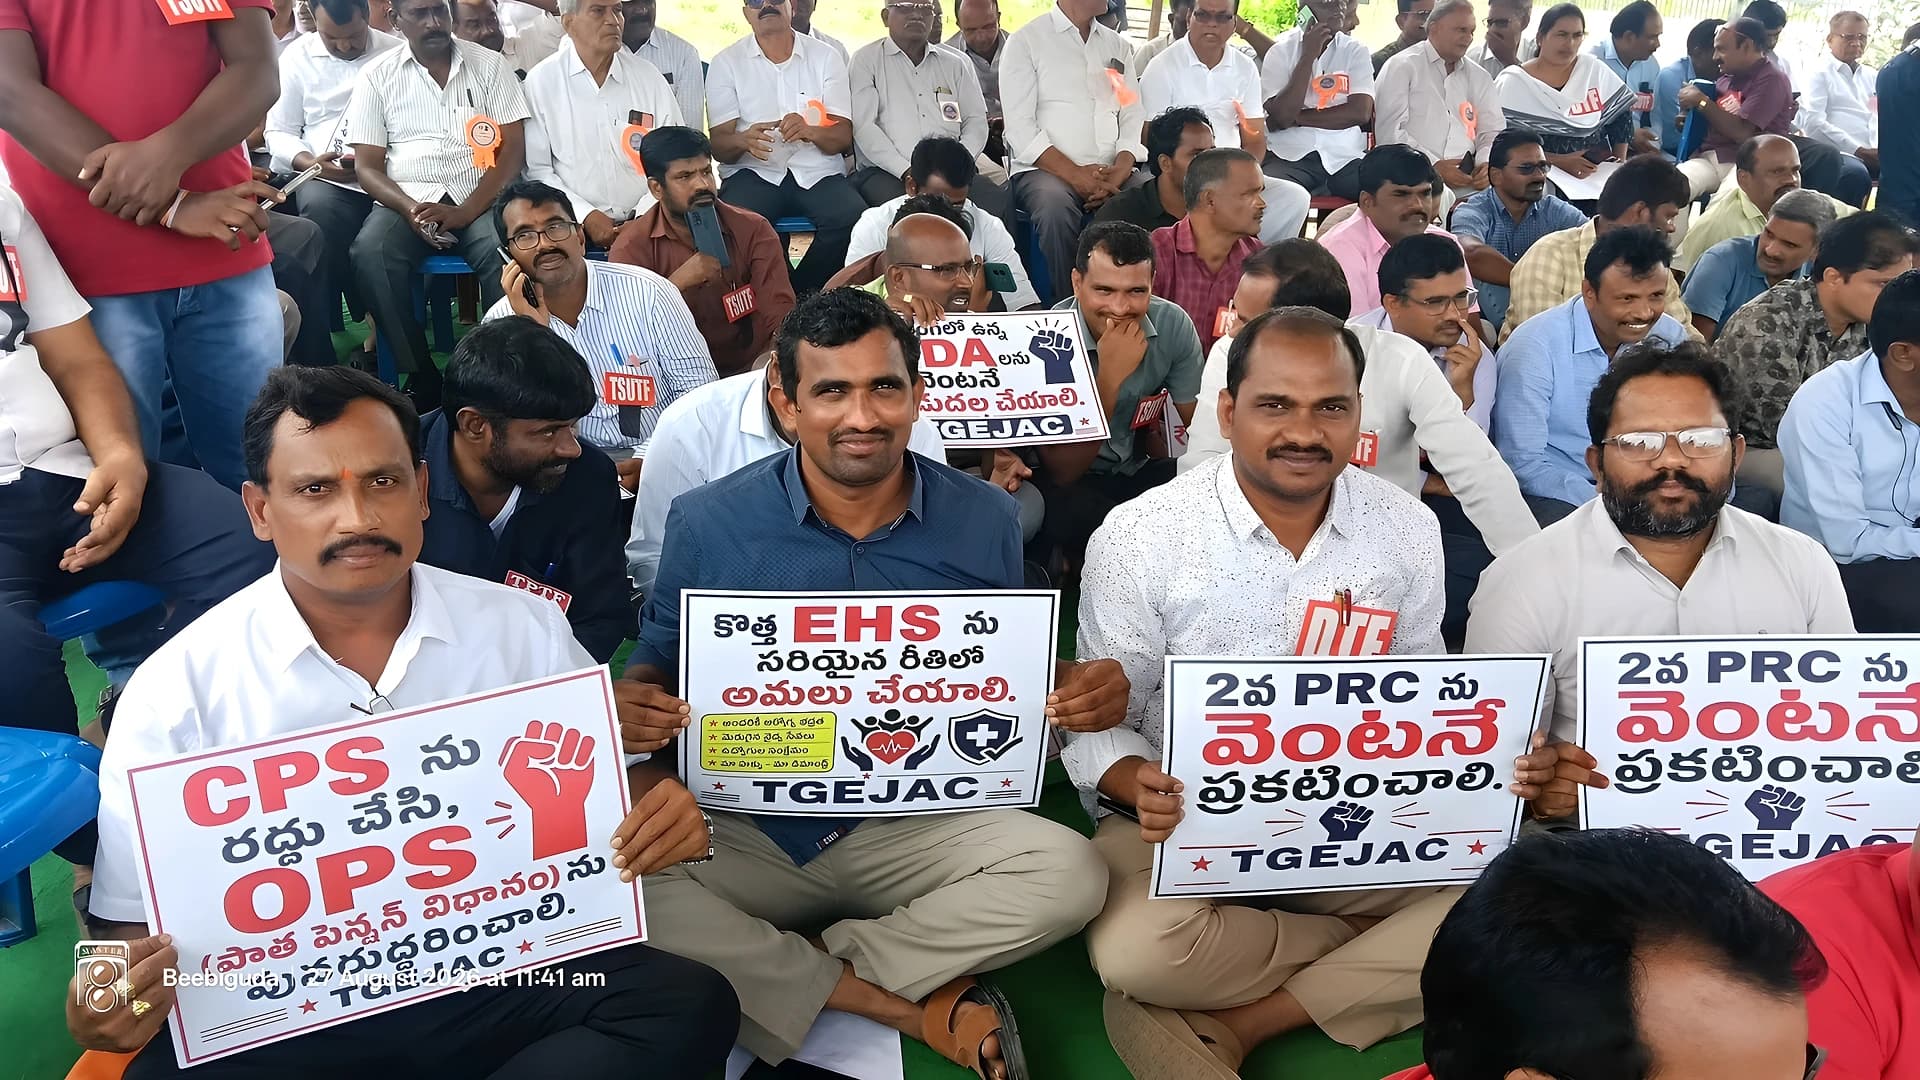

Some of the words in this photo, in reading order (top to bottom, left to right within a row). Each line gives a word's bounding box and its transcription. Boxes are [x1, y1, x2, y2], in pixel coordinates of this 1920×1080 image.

[725, 287, 754, 318] TSUTF
[971, 322, 1009, 341] ఉన్న
[609, 376, 650, 402] TSUTF
[995, 388, 1086, 412] చేయాలి.
[935, 417, 1065, 439] GEJAC
[713, 612, 778, 646] కొత్త
[793, 604, 942, 643] EHS
[962, 610, 998, 636] ను
[756, 648, 887, 679] సరియైన
[899, 644, 984, 672] రీతిలో
[1617, 651, 1689, 685] 2వ
[1707, 649, 1842, 684] PRC
[1863, 652, 1909, 683] ను
[721, 679, 853, 708] అమలు
[866, 673, 1017, 706] చేయాలి.
[1205, 672, 1277, 708] 2వ
[1294, 670, 1419, 706] PRC
[1438, 672, 1480, 701] ను
[1616, 681, 1920, 743] వెంటనే
[1202, 698, 1506, 767] వెంటనే
[183, 735, 390, 828] CPS
[420, 734, 481, 776] ను
[752, 776, 980, 804] TGEJAC
[1196, 761, 1504, 815] ప్రకటించాలి.
[221, 815, 326, 867] రద్దు
[347, 786, 459, 836] చేసి,
[1231, 837, 1450, 873] TGEJAC
[1676, 833, 1898, 860] GEJA
[223, 825, 478, 934] OPS
[567, 854, 606, 882] ను
